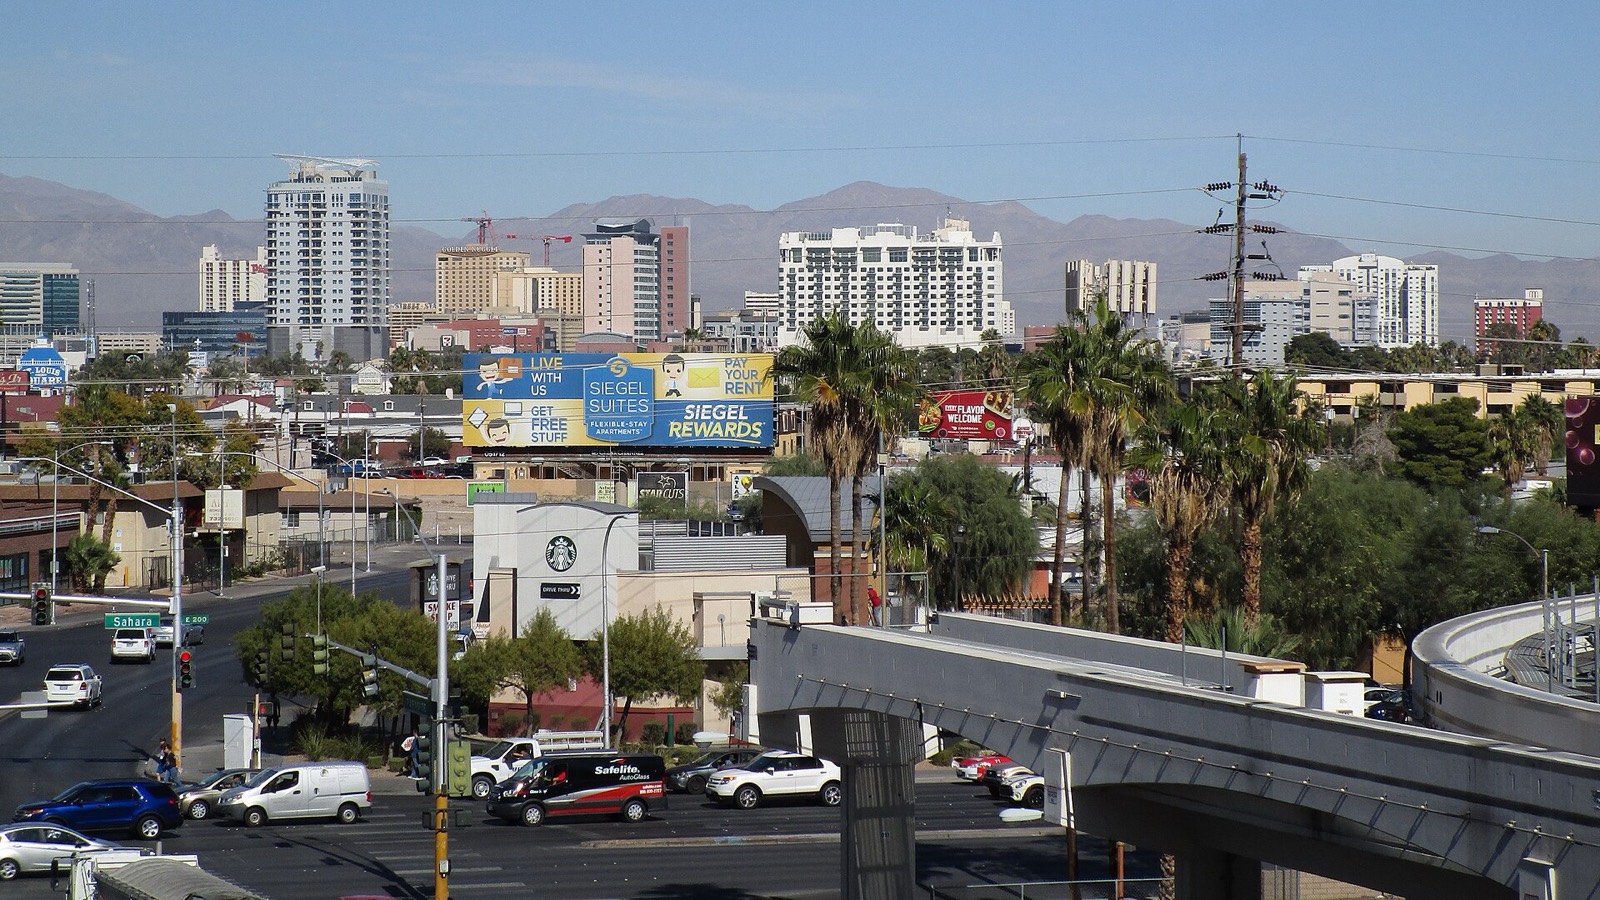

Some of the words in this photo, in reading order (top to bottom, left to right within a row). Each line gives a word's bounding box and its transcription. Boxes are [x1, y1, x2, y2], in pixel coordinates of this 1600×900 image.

[531, 357, 562, 370] LIVE
[725, 357, 747, 368] PAY
[36, 367, 60, 376] LOUIS
[725, 369, 758, 380] YOUR
[531, 373, 562, 383] WITH
[531, 385, 547, 396] US
[589, 381, 648, 395] SIEGEL
[725, 381, 763, 394] RENT
[531, 406, 554, 416] GET
[589, 398, 649, 413] SUITES
[957, 405, 985, 414] FLAVOR
[684, 404, 749, 420] SIEGEL
[948, 413, 982, 423] WELCOME
[531, 418, 567, 431] FREE
[668, 421, 763, 438] REWARDS
[531, 432, 567, 443] STUFF
[639, 488, 662, 499] STAR
[663, 488, 685, 499] CUTS
[113, 616, 153, 627] Sahara
